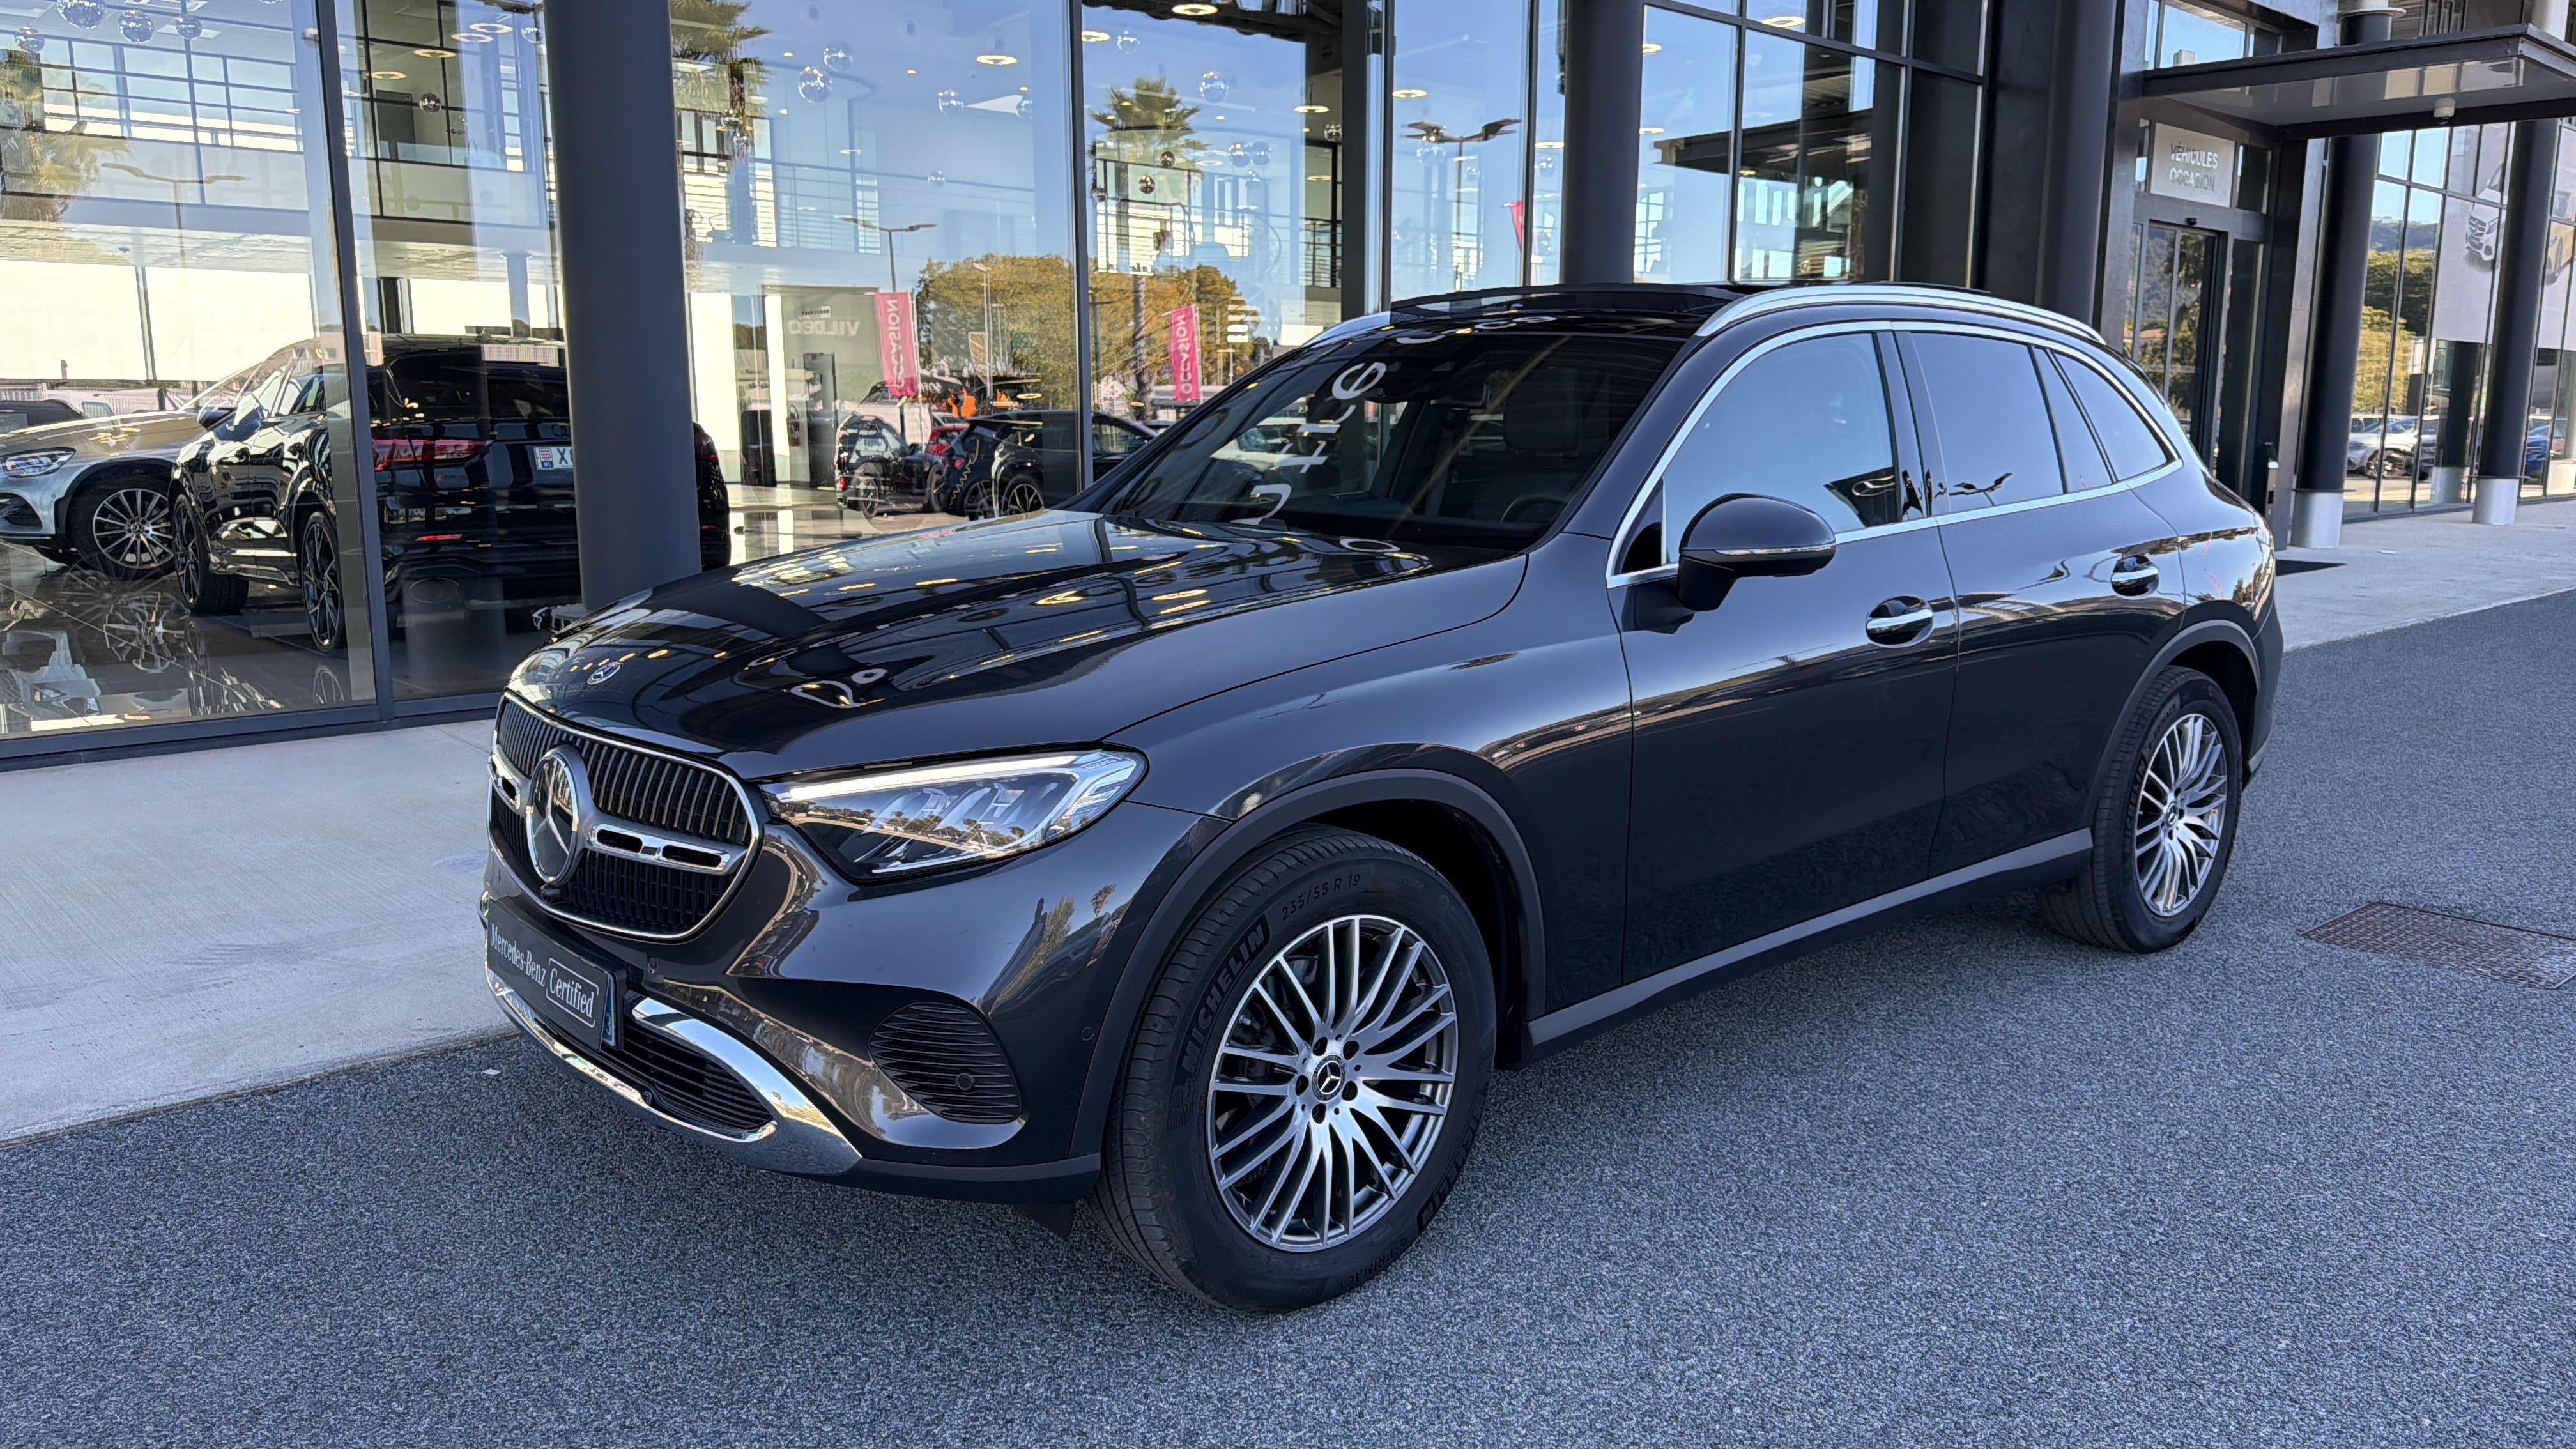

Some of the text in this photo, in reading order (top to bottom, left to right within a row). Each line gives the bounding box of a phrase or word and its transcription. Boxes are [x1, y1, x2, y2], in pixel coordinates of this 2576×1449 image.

[1282, 882, 1328, 921] 235/55
[1333, 878, 1342, 892] R
[1347, 873, 1361, 887] 19
[490, 923, 595, 1018] Mercedes-Benz Certified
[1181, 923, 1266, 1074] MICHELIN
